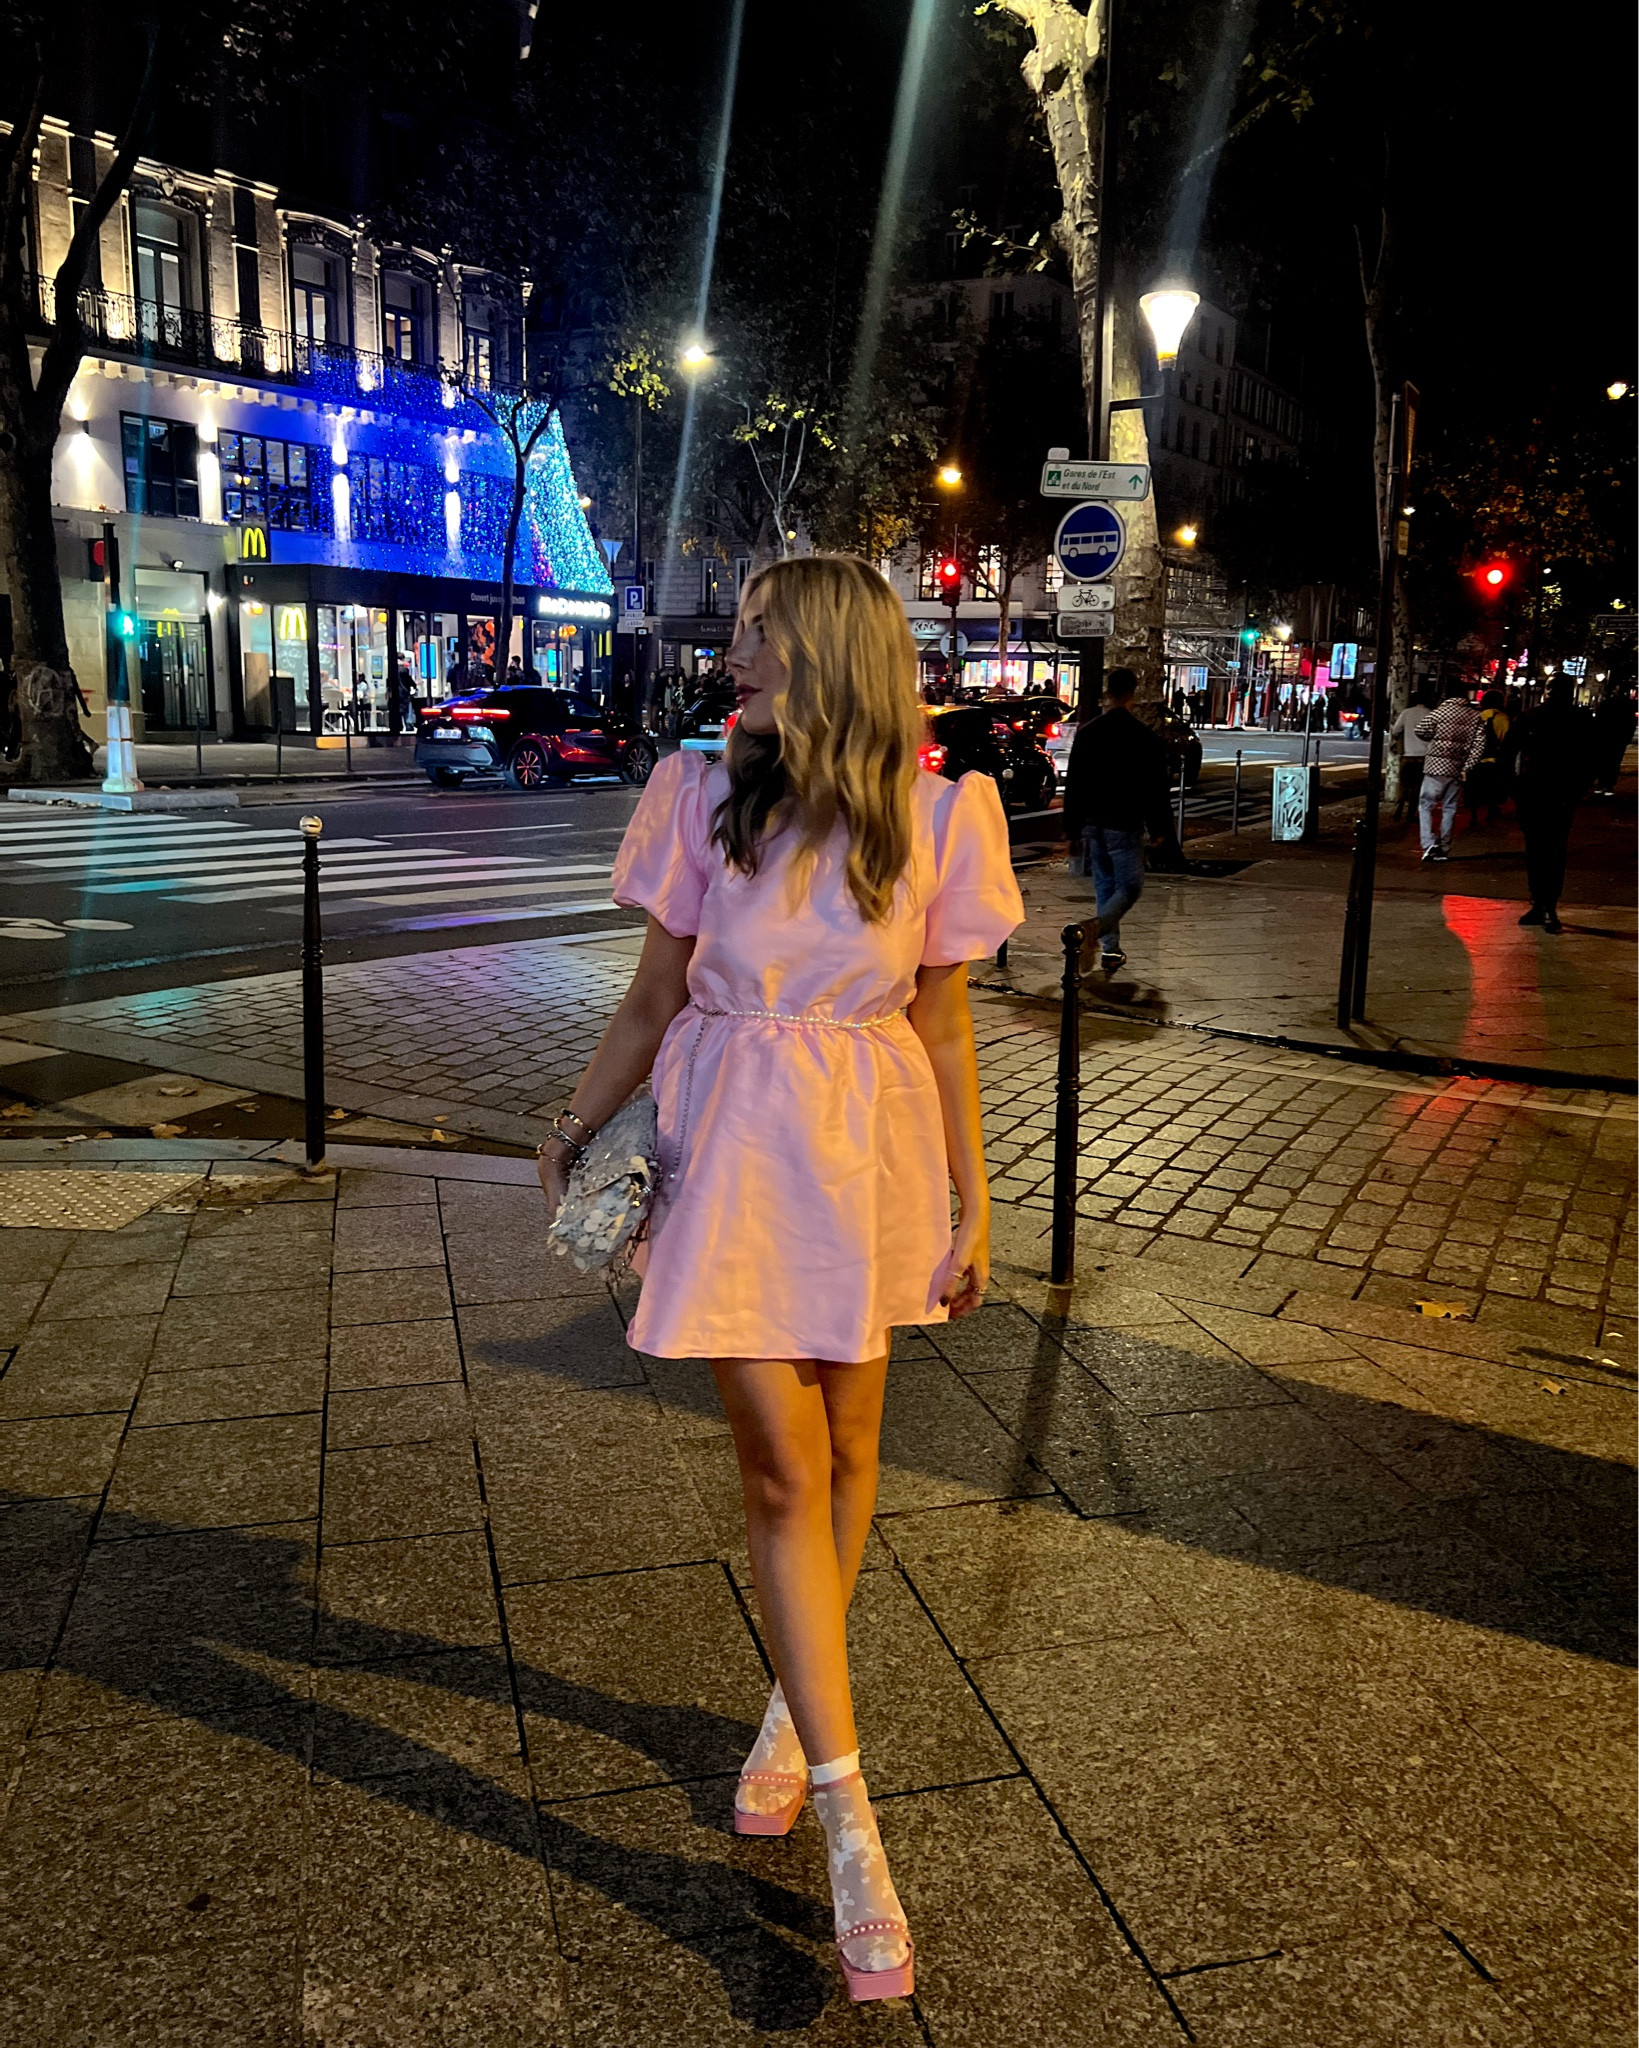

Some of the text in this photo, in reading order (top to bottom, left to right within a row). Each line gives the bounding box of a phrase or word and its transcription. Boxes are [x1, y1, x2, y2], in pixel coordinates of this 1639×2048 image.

[1063, 468, 1116, 479] Gares de l'Est
[1062, 481, 1101, 491] et du Nord
[470, 592, 489, 603] Ouvert
